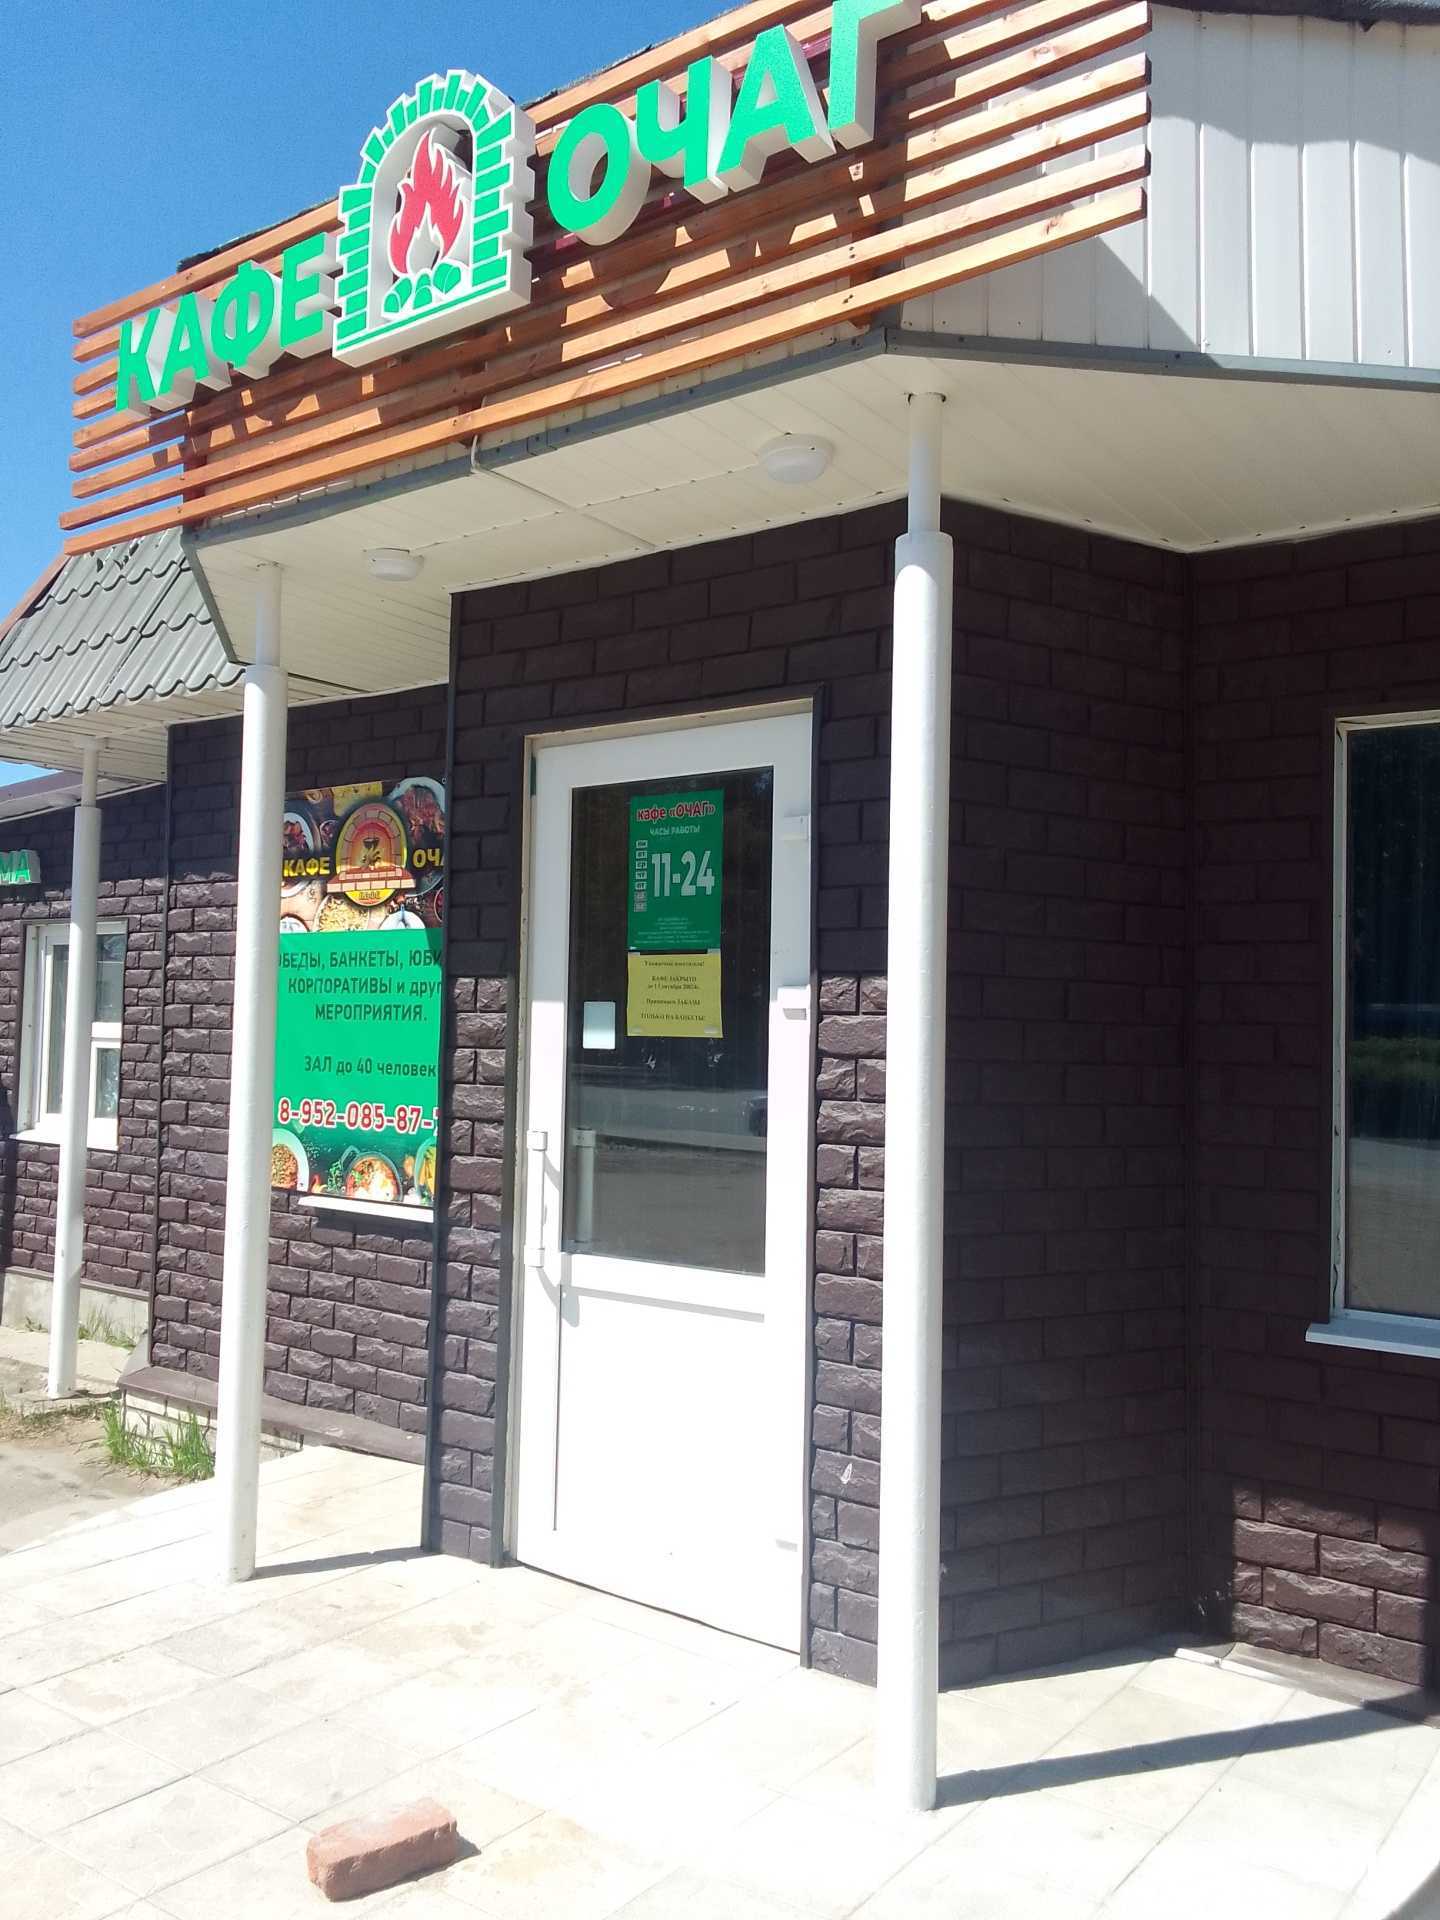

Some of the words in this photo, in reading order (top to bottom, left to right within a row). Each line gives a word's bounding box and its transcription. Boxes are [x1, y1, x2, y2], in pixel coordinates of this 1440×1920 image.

[115, 231, 332, 416] КАФЕ
[546, 0, 906, 234] ОЧАГ
[636, 806, 667, 824] кафе
[671, 824, 701, 835] РАБОТЫ
[282, 856, 331, 878] КАФЕ
[412, 848, 445, 869] ОЧ
[651, 850, 716, 897] 11-24
[329, 950, 404, 970] БАНКЕТЫ,
[288, 976, 392, 994] КОРПОРАТИВЫ
[396, 981, 406, 994] и
[315, 1003, 428, 1022] МЕРОПРИЯТИЯ.
[304, 1055, 332, 1073] ЗАЛ
[336, 1060, 353, 1077] до
[357, 1058, 373, 1074] 40
